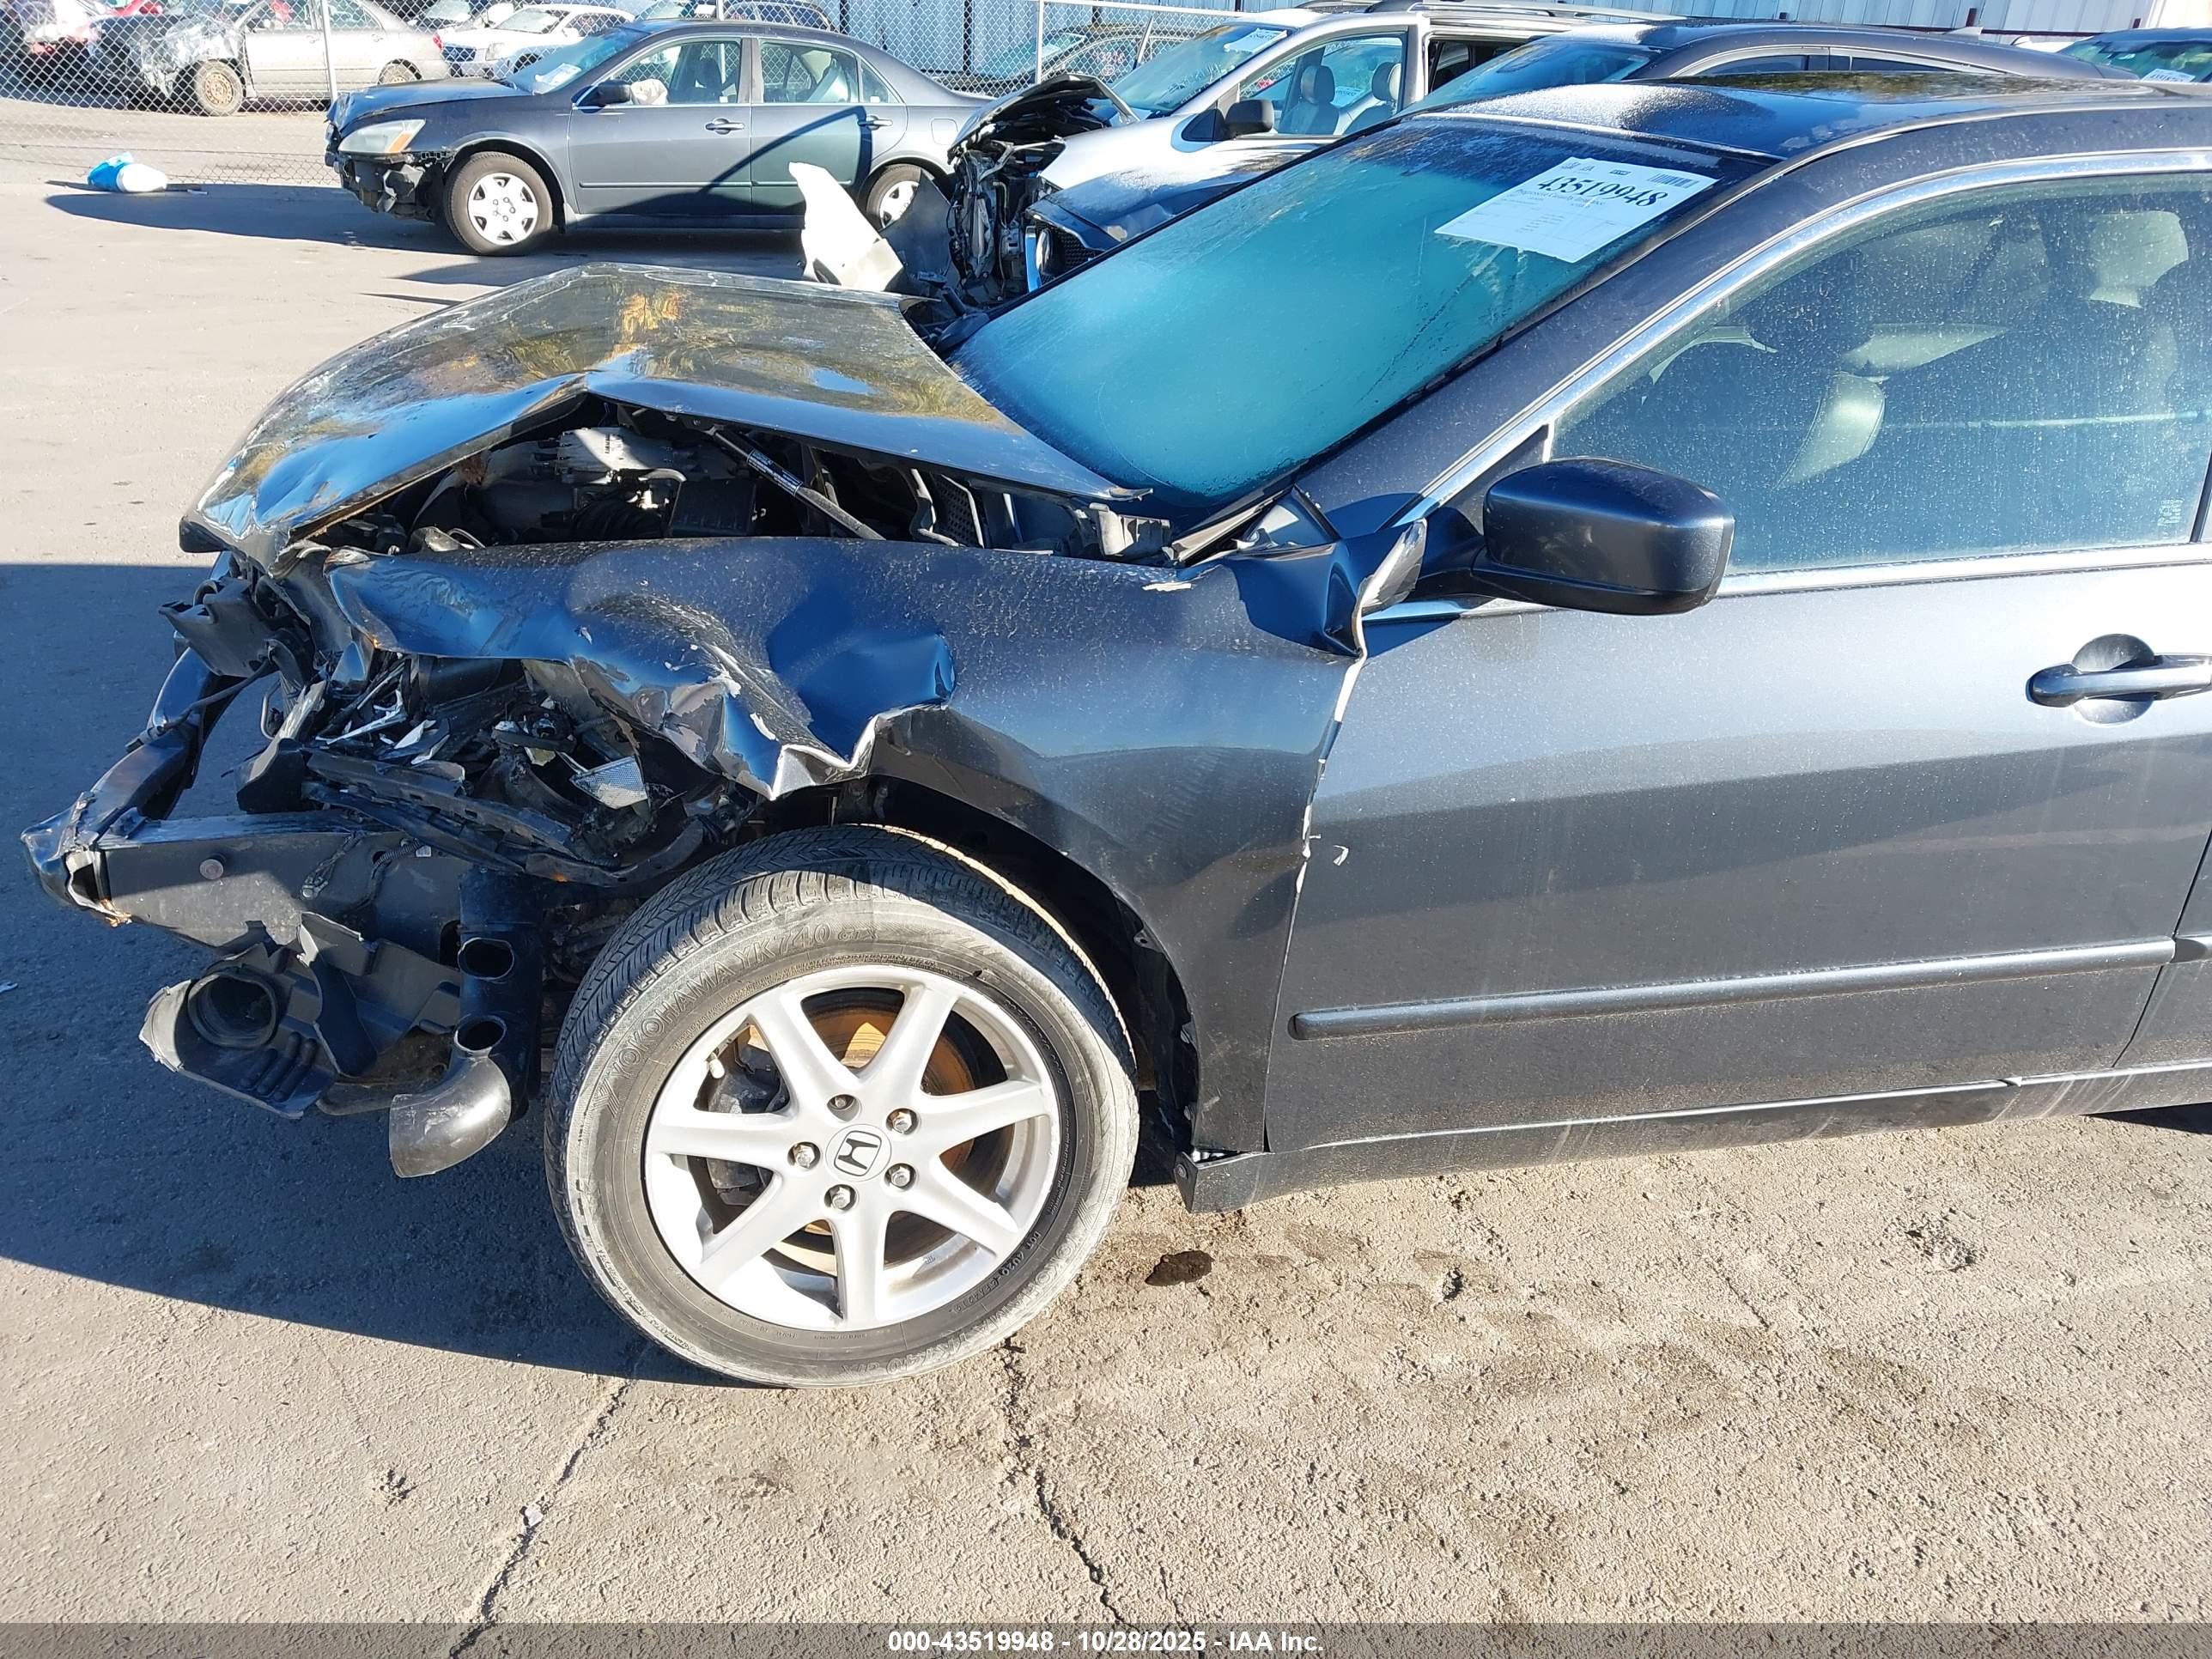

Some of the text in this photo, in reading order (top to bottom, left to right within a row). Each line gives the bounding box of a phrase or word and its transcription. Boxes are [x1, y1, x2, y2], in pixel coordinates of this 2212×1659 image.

[1536, 175, 1668, 208] 43519948
[611, 961, 735, 1079] YOKOHAMA
[734, 921, 831, 969] YK740
[1025, 1230, 1042, 1250] DOT
